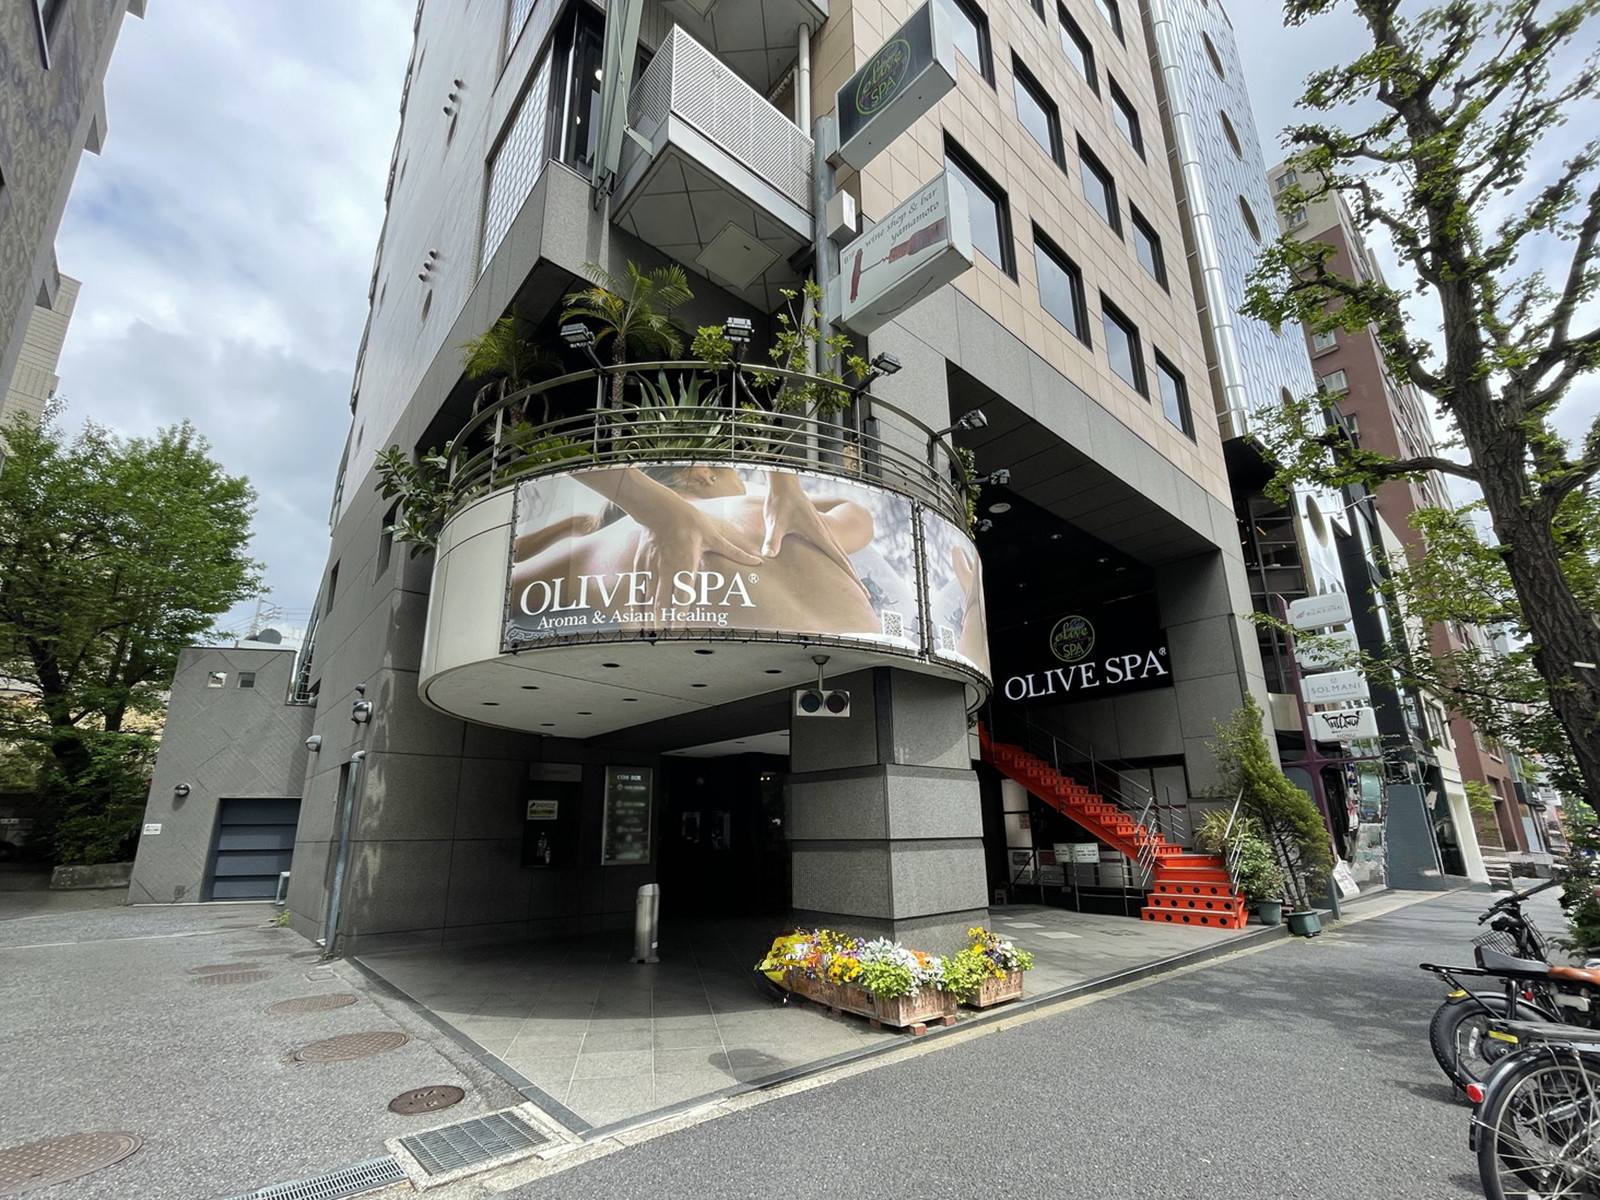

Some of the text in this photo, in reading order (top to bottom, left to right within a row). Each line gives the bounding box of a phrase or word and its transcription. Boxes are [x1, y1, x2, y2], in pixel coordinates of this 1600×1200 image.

[870, 76, 897, 107] SPA
[865, 228, 885, 248] wine
[886, 213, 907, 232] shop
[908, 202, 918, 214] &
[920, 187, 938, 205] bar
[890, 201, 940, 247] yamamoto
[519, 571, 654, 616] OLIVE
[537, 608, 729, 630] Aroma & Asian Healing
[1063, 643, 1085, 658] SPA
[1004, 662, 1100, 701] OLIVE
[1311, 683, 1361, 694] SOLMANI
